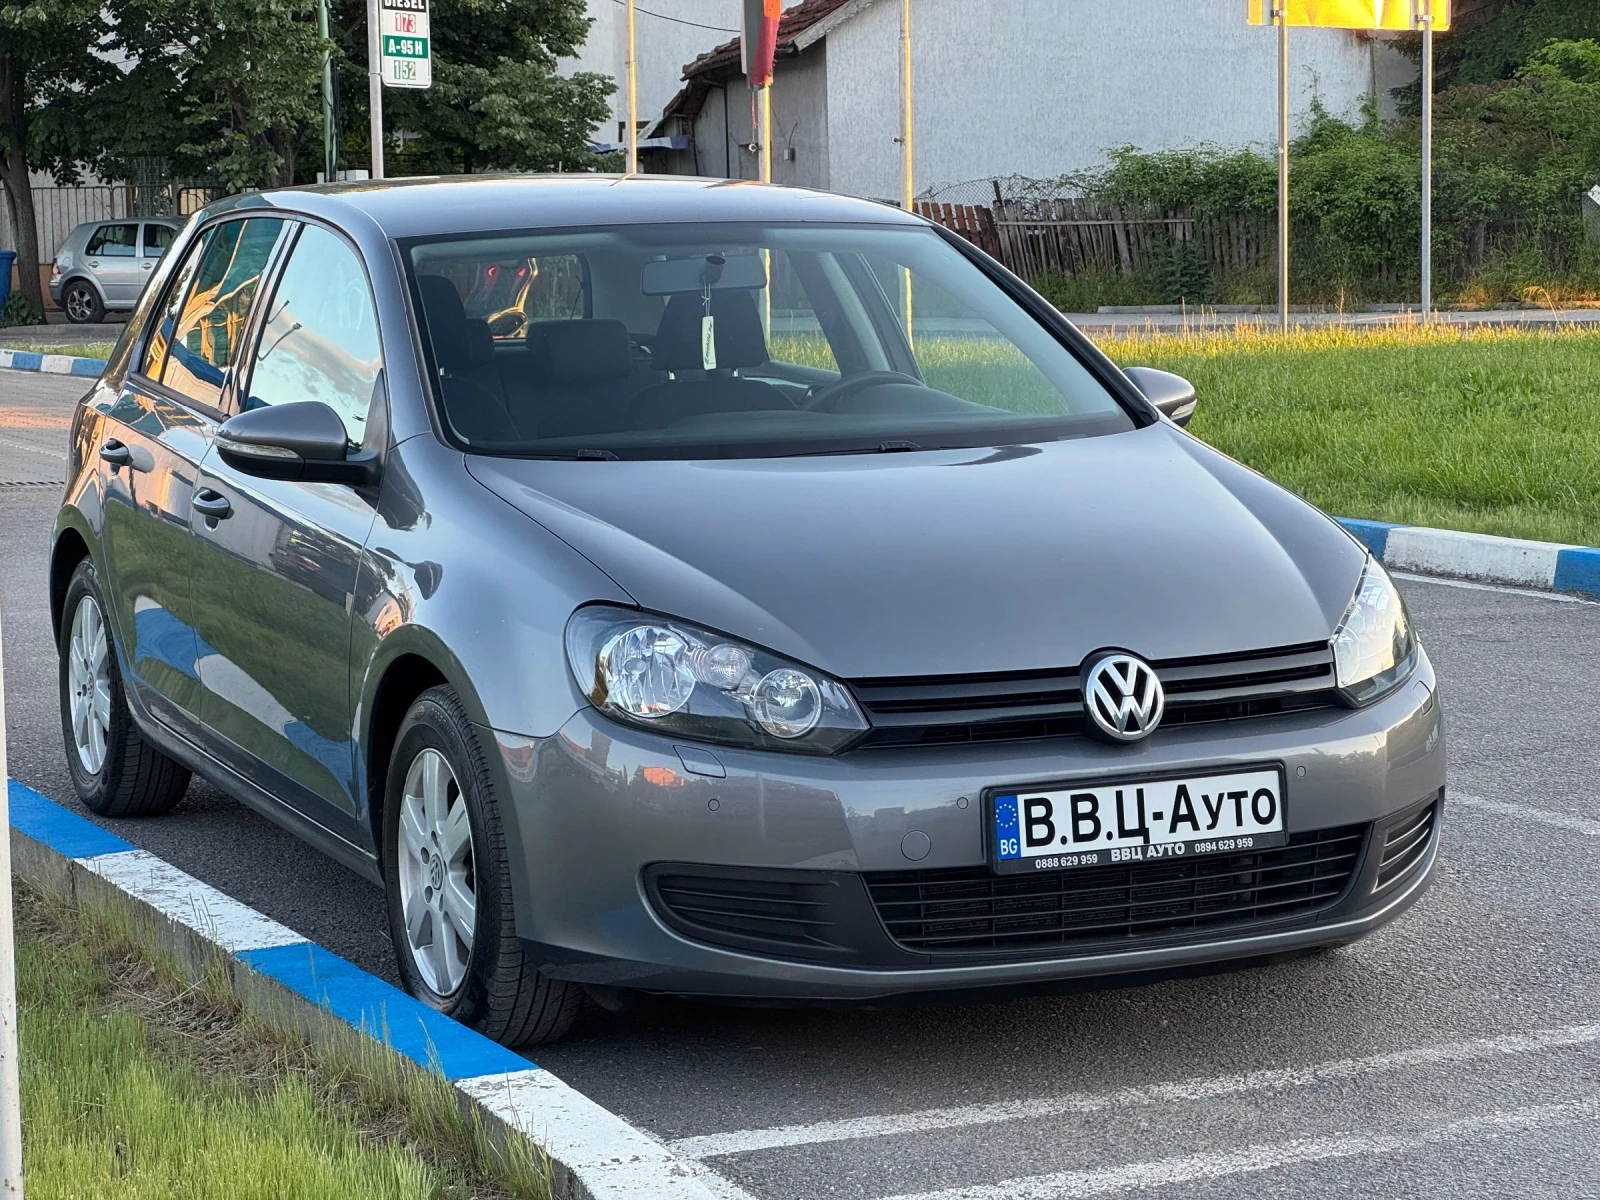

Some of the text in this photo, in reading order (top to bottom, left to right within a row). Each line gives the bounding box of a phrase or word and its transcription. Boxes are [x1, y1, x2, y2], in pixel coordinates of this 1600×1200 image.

[395, 13, 416, 33] 173
[394, 60, 416, 80] 152
[1000, 838, 1018, 855] BG
[1110, 842, 1185, 862] ВВЦ АУТО
[1194, 837, 1253, 853] 0894 629 959
[1035, 854, 1098, 869] 0888 629 959
